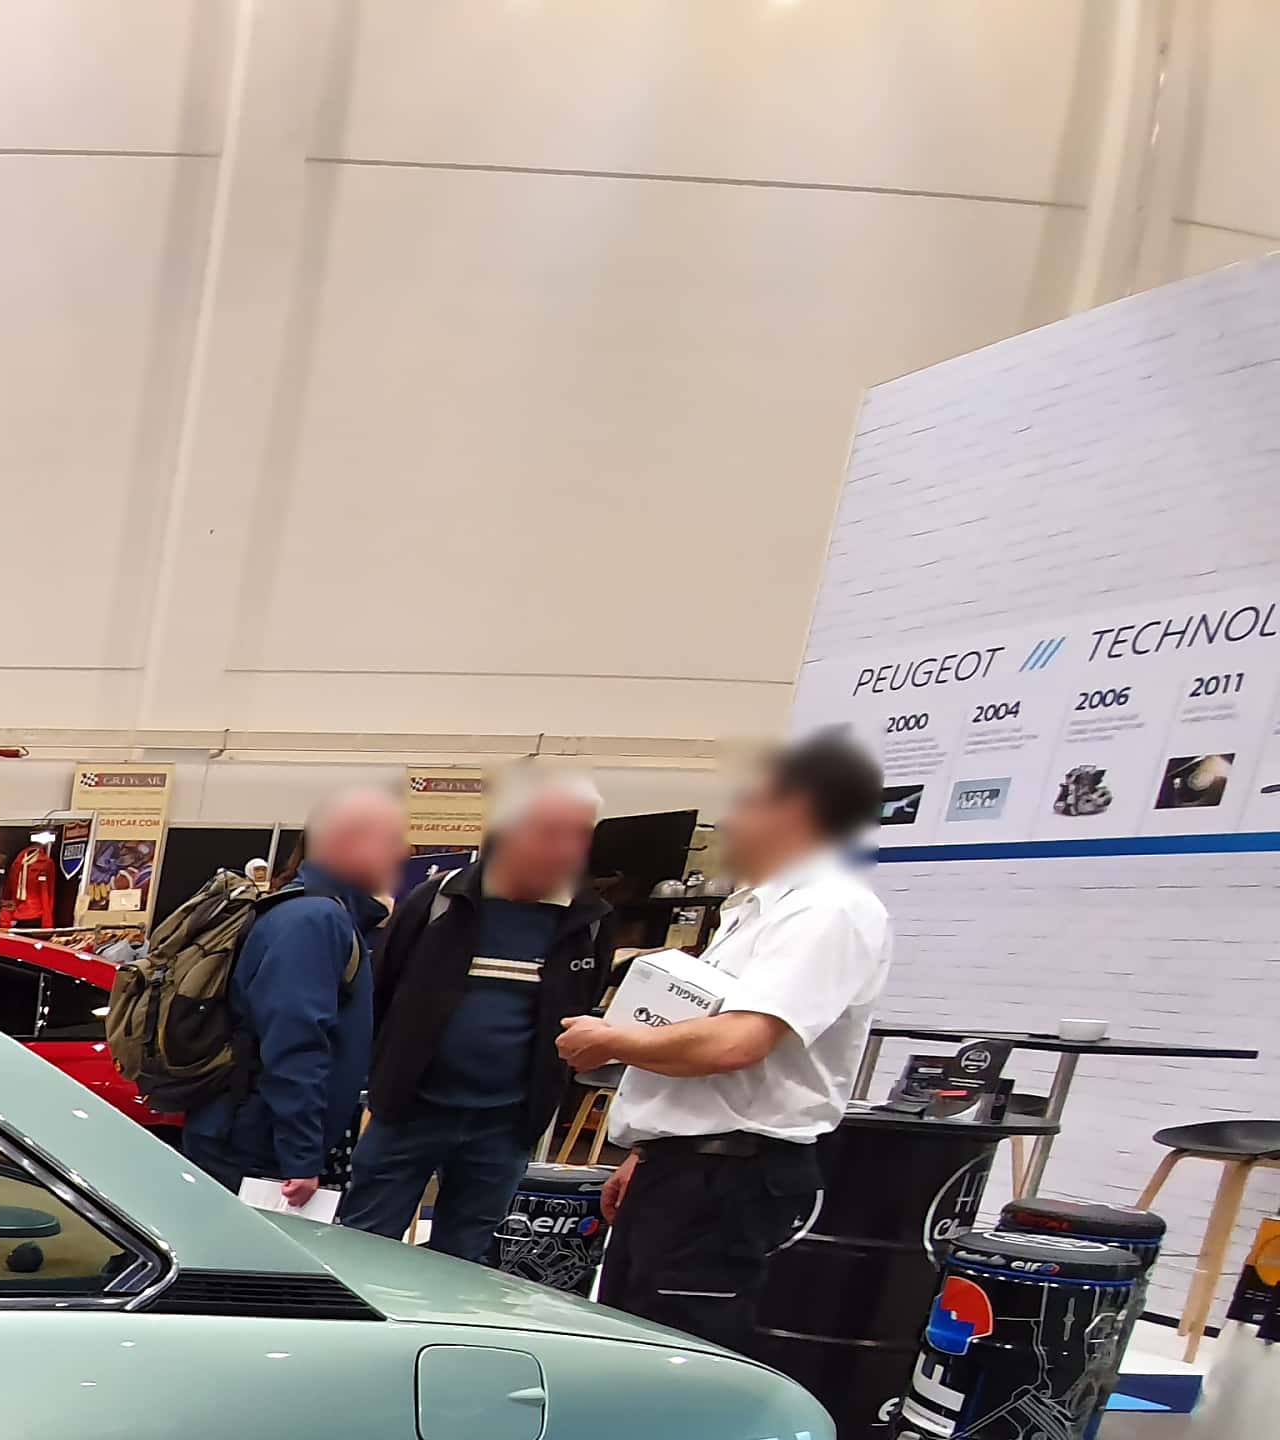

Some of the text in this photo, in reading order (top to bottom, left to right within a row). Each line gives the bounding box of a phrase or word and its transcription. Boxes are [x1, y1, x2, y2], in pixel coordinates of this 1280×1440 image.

[852, 603, 1280, 697] PEUGEOT TECHNOL
[1189, 672, 1245, 698] 2011
[1074, 686, 1132, 711] 2006
[886, 713, 929, 733] 2000
[972, 700, 1021, 723] 2004
[667, 982, 711, 1010] FRAGILE
[532, 1216, 580, 1234] elf
[1010, 1260, 1042, 1272] elf
